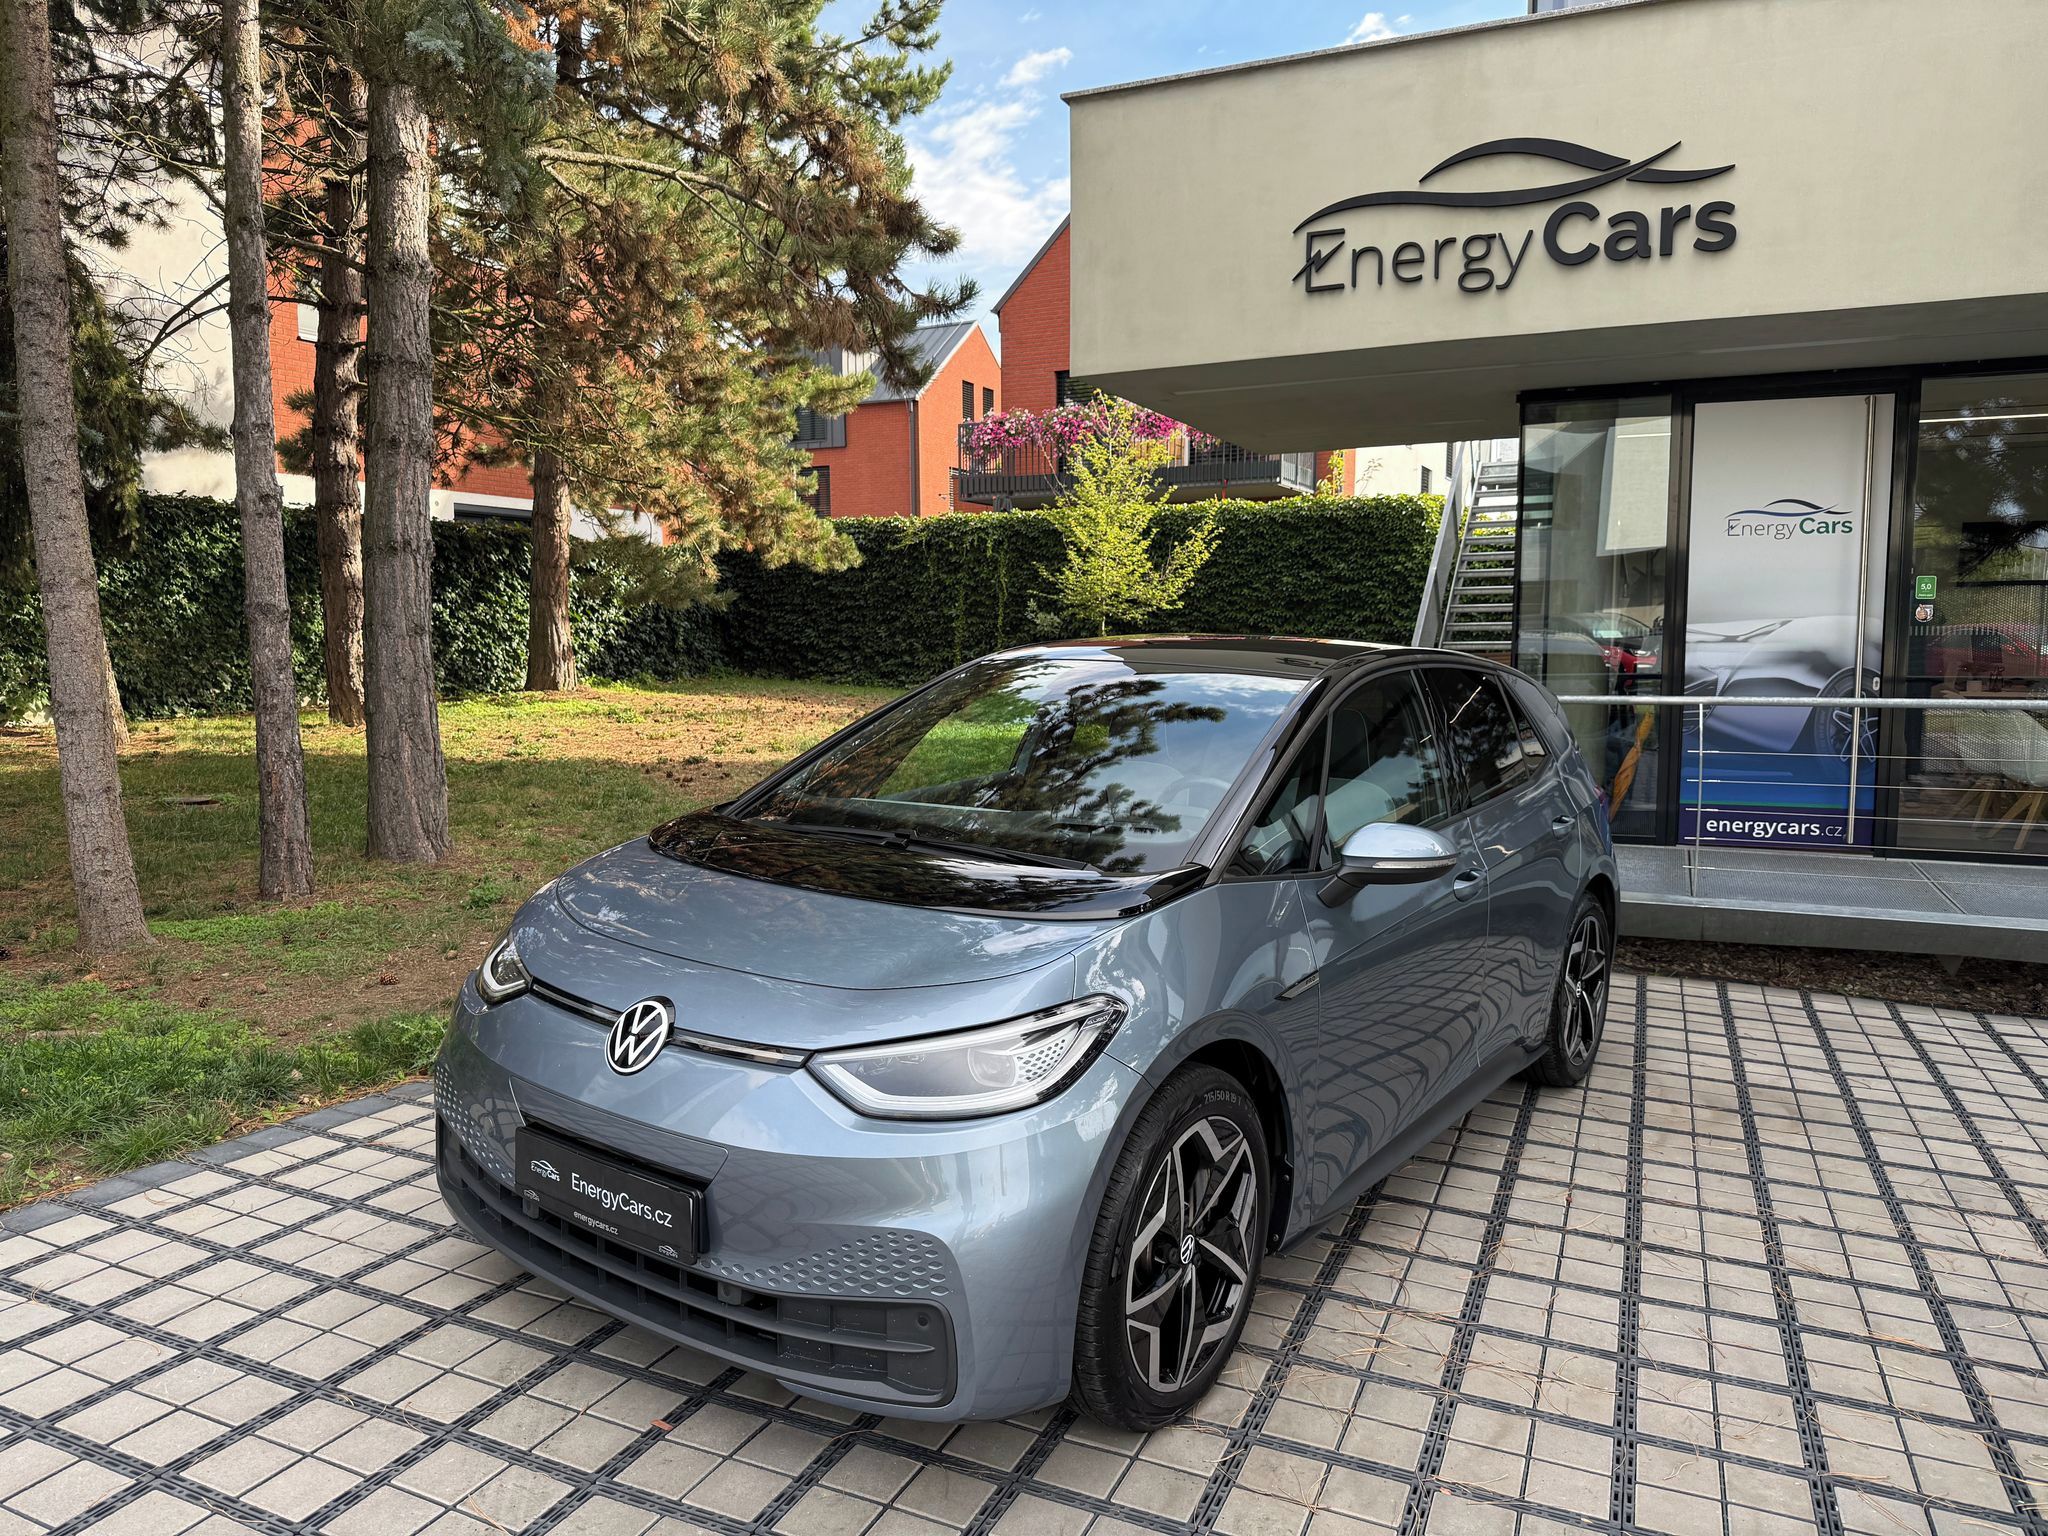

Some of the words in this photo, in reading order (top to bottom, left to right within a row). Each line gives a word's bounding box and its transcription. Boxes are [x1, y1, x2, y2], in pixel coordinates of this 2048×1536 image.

[1706, 819, 1843, 838] energycars.cz
[571, 1172, 673, 1228] EnergyCars.cz
[573, 1210, 619, 1235] energycars.cz
